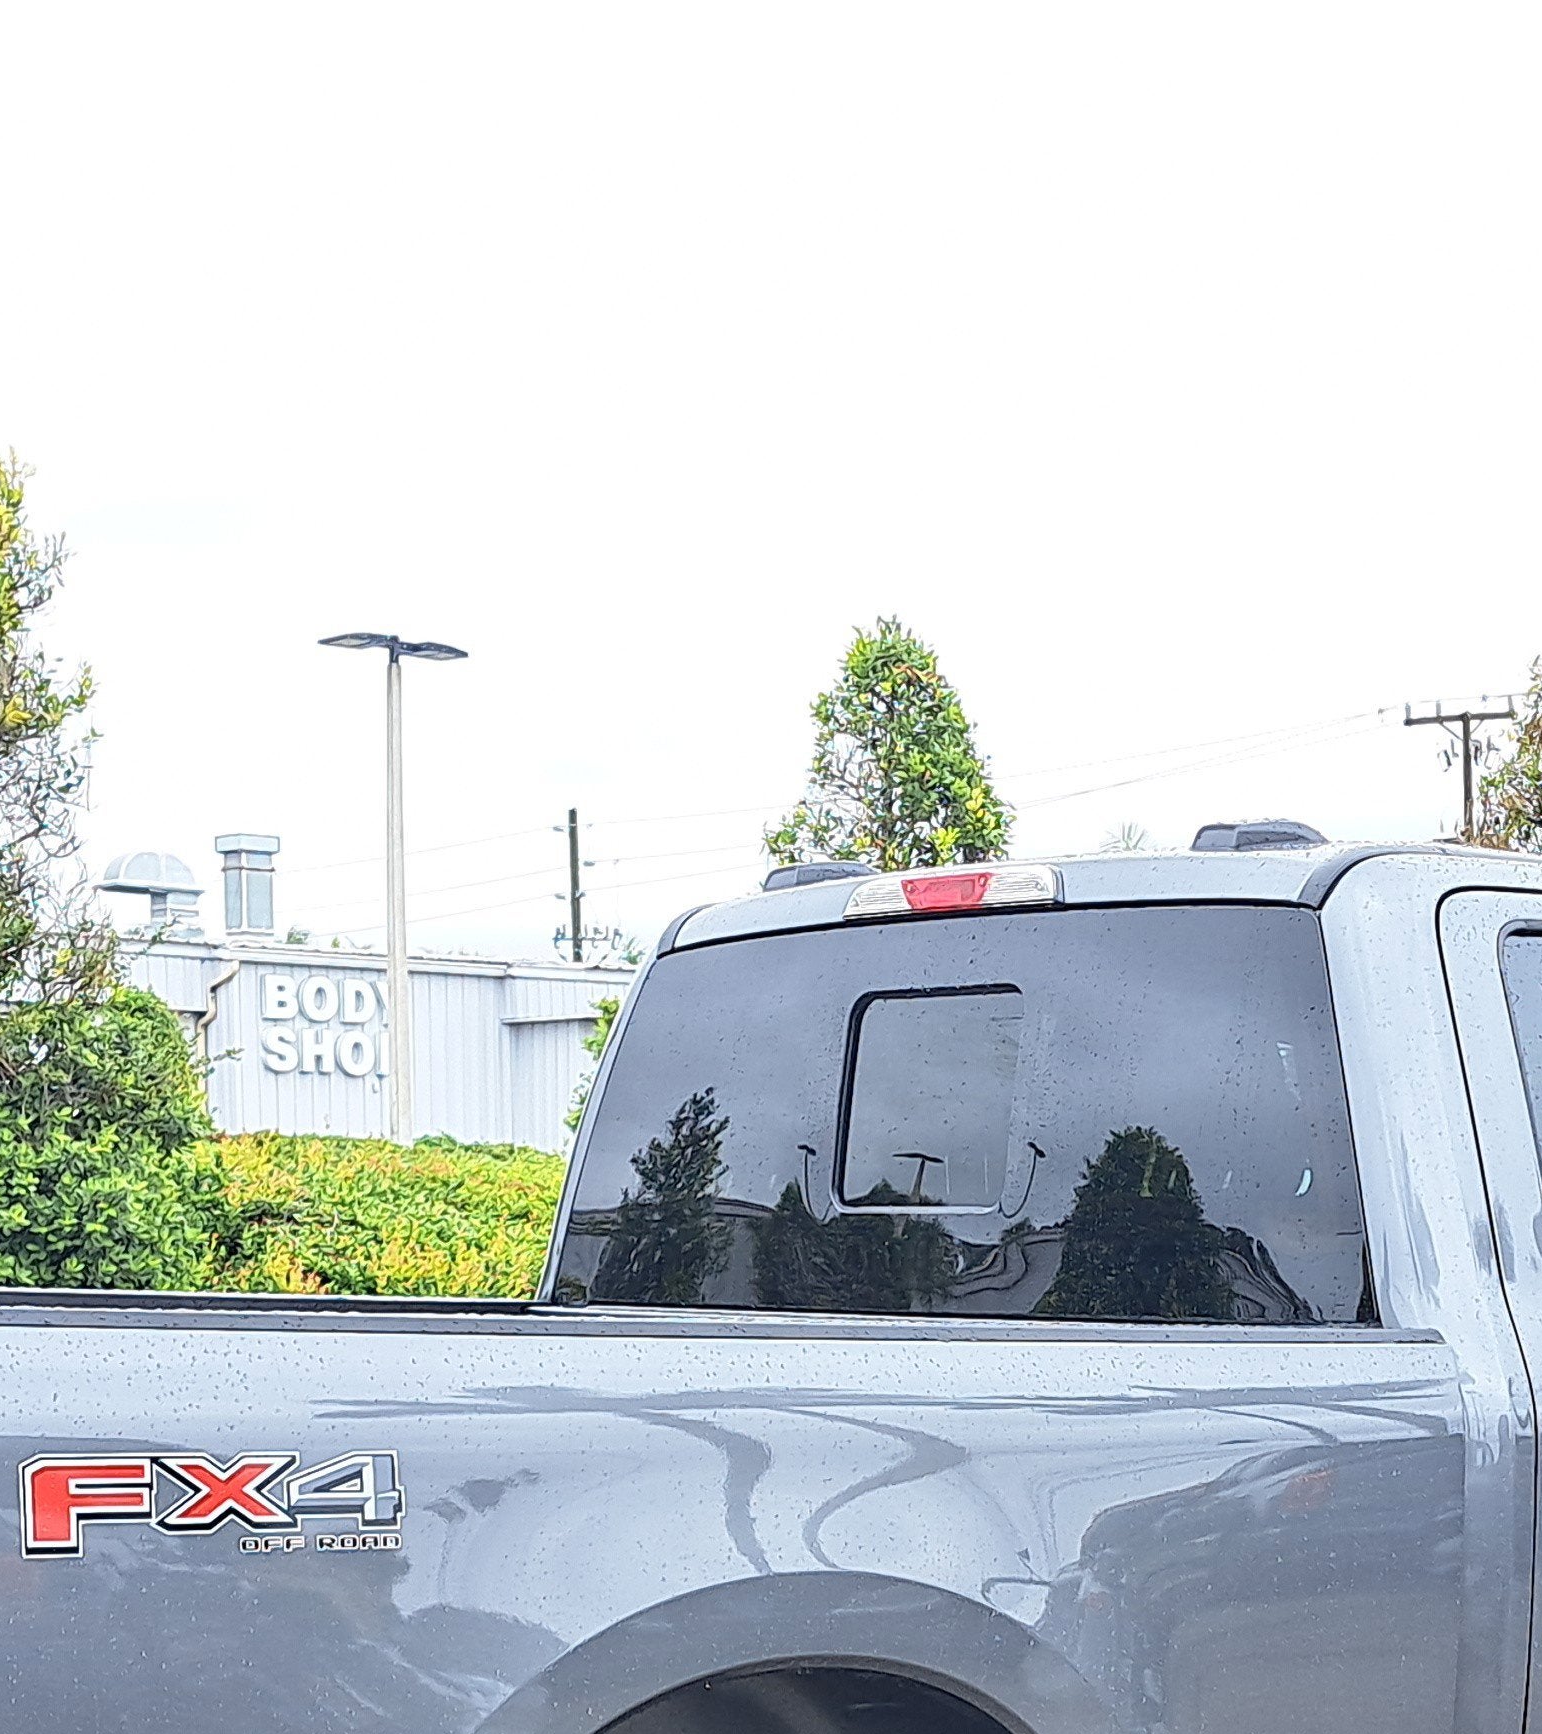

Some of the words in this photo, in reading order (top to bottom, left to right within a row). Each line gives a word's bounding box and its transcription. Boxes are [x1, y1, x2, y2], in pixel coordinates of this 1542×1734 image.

[18, 1450, 406, 1559] FX4
[240, 1535, 307, 1553] OFF
[316, 1534, 402, 1552] ROAD
